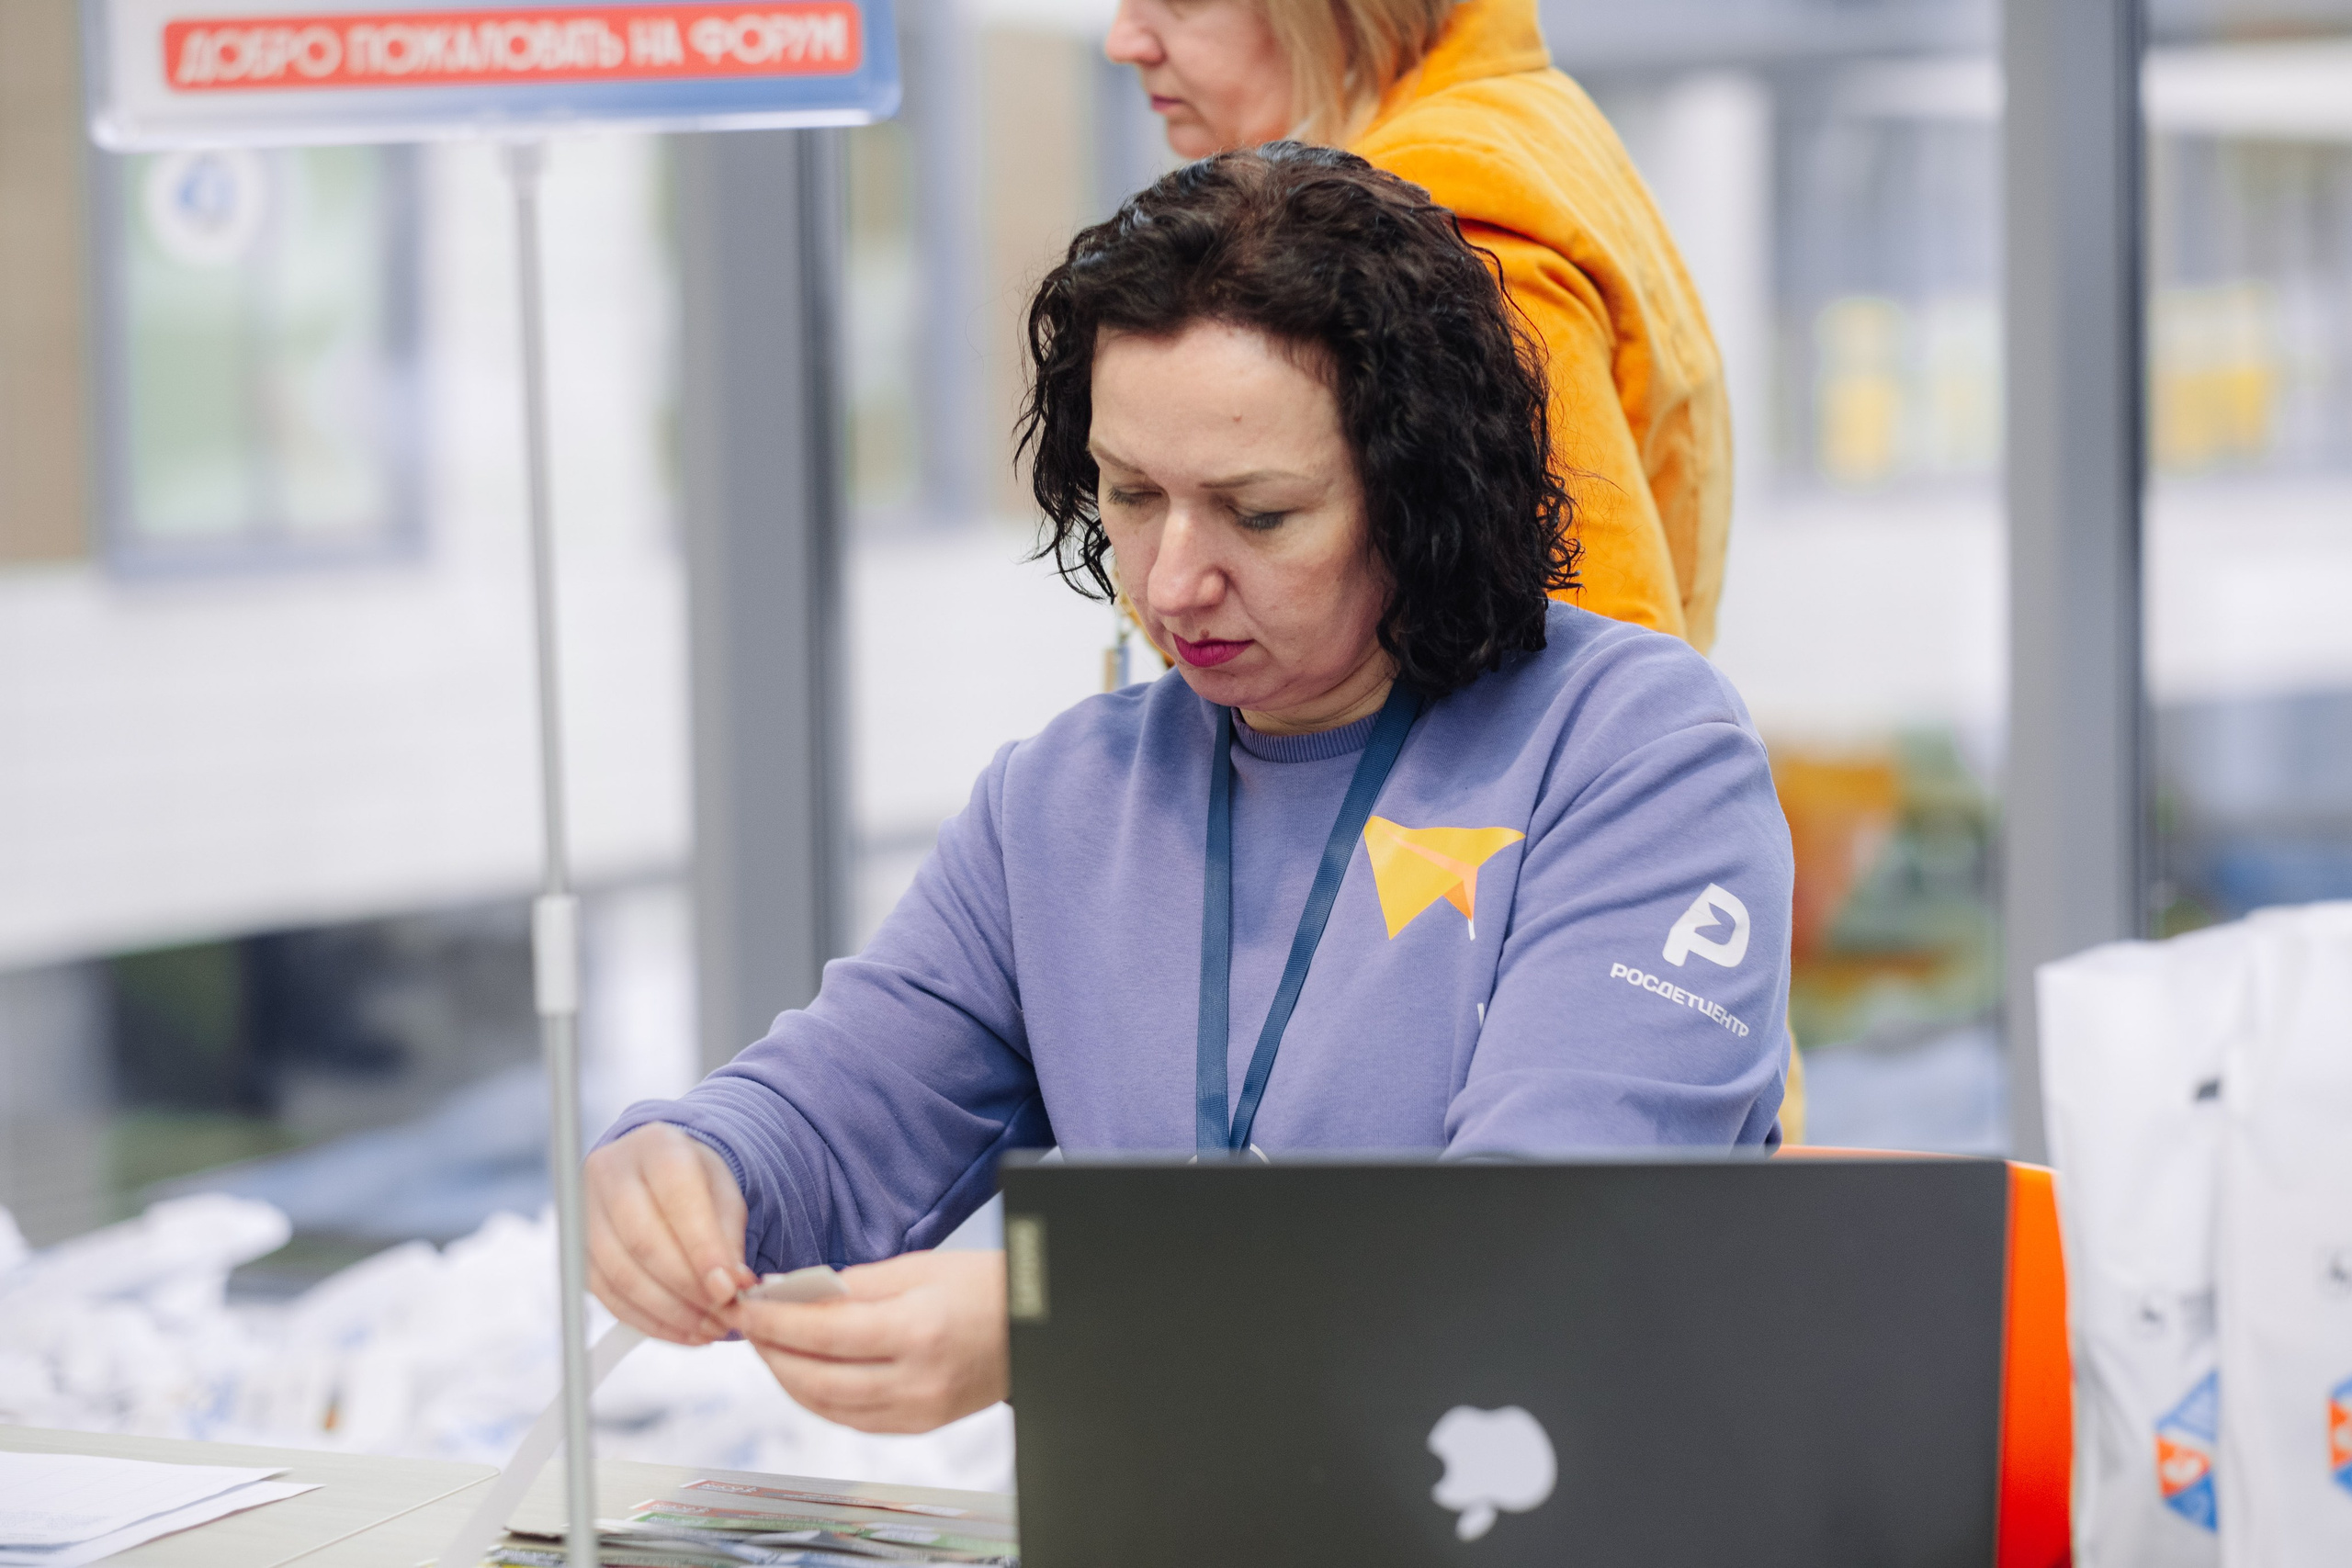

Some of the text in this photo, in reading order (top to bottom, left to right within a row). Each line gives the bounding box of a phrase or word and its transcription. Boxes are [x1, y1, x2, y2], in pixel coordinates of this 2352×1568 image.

[177, 12, 848, 84] ДОБРО ПОЖАЛОВАТЬ НА ФОРУМ
[1610, 963, 1749, 1037] РОСДЕТЦЕНТР
